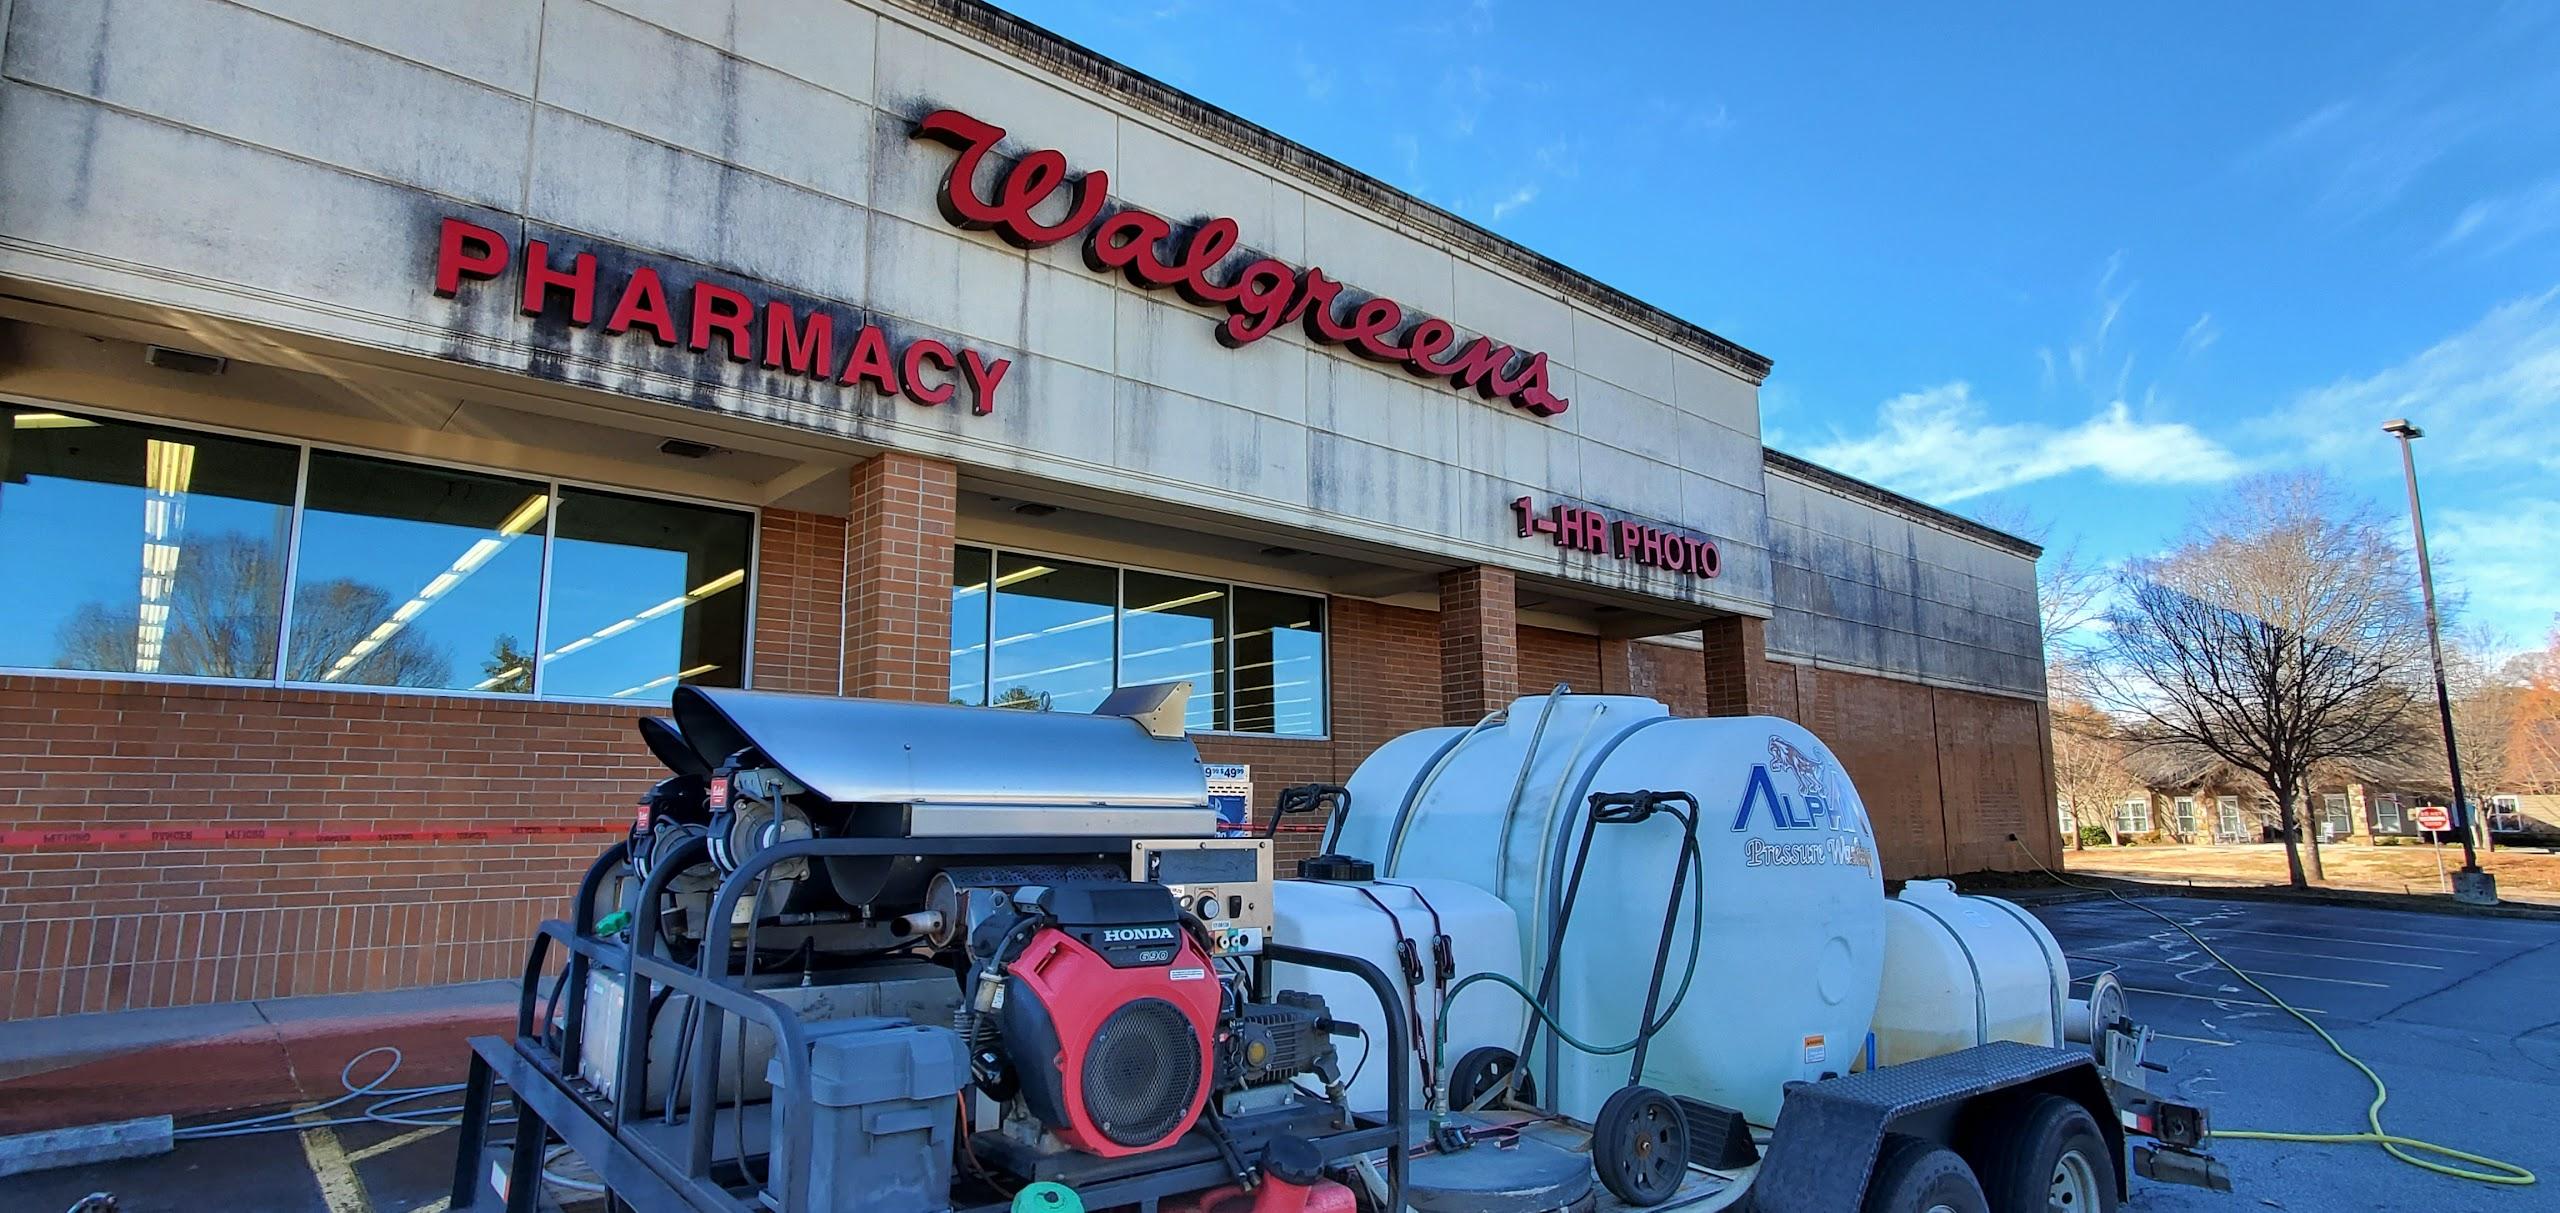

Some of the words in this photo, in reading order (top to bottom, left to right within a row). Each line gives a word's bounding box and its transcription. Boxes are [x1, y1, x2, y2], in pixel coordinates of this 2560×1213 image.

[912, 109, 1569, 417] Walgreens
[434, 217, 1011, 416] PHARMACY
[1511, 496, 1609, 554] 1-HR
[1613, 520, 1721, 578] PHOTO
[1745, 838, 1826, 867] Pressure
[1104, 928, 1174, 941] HONDA
